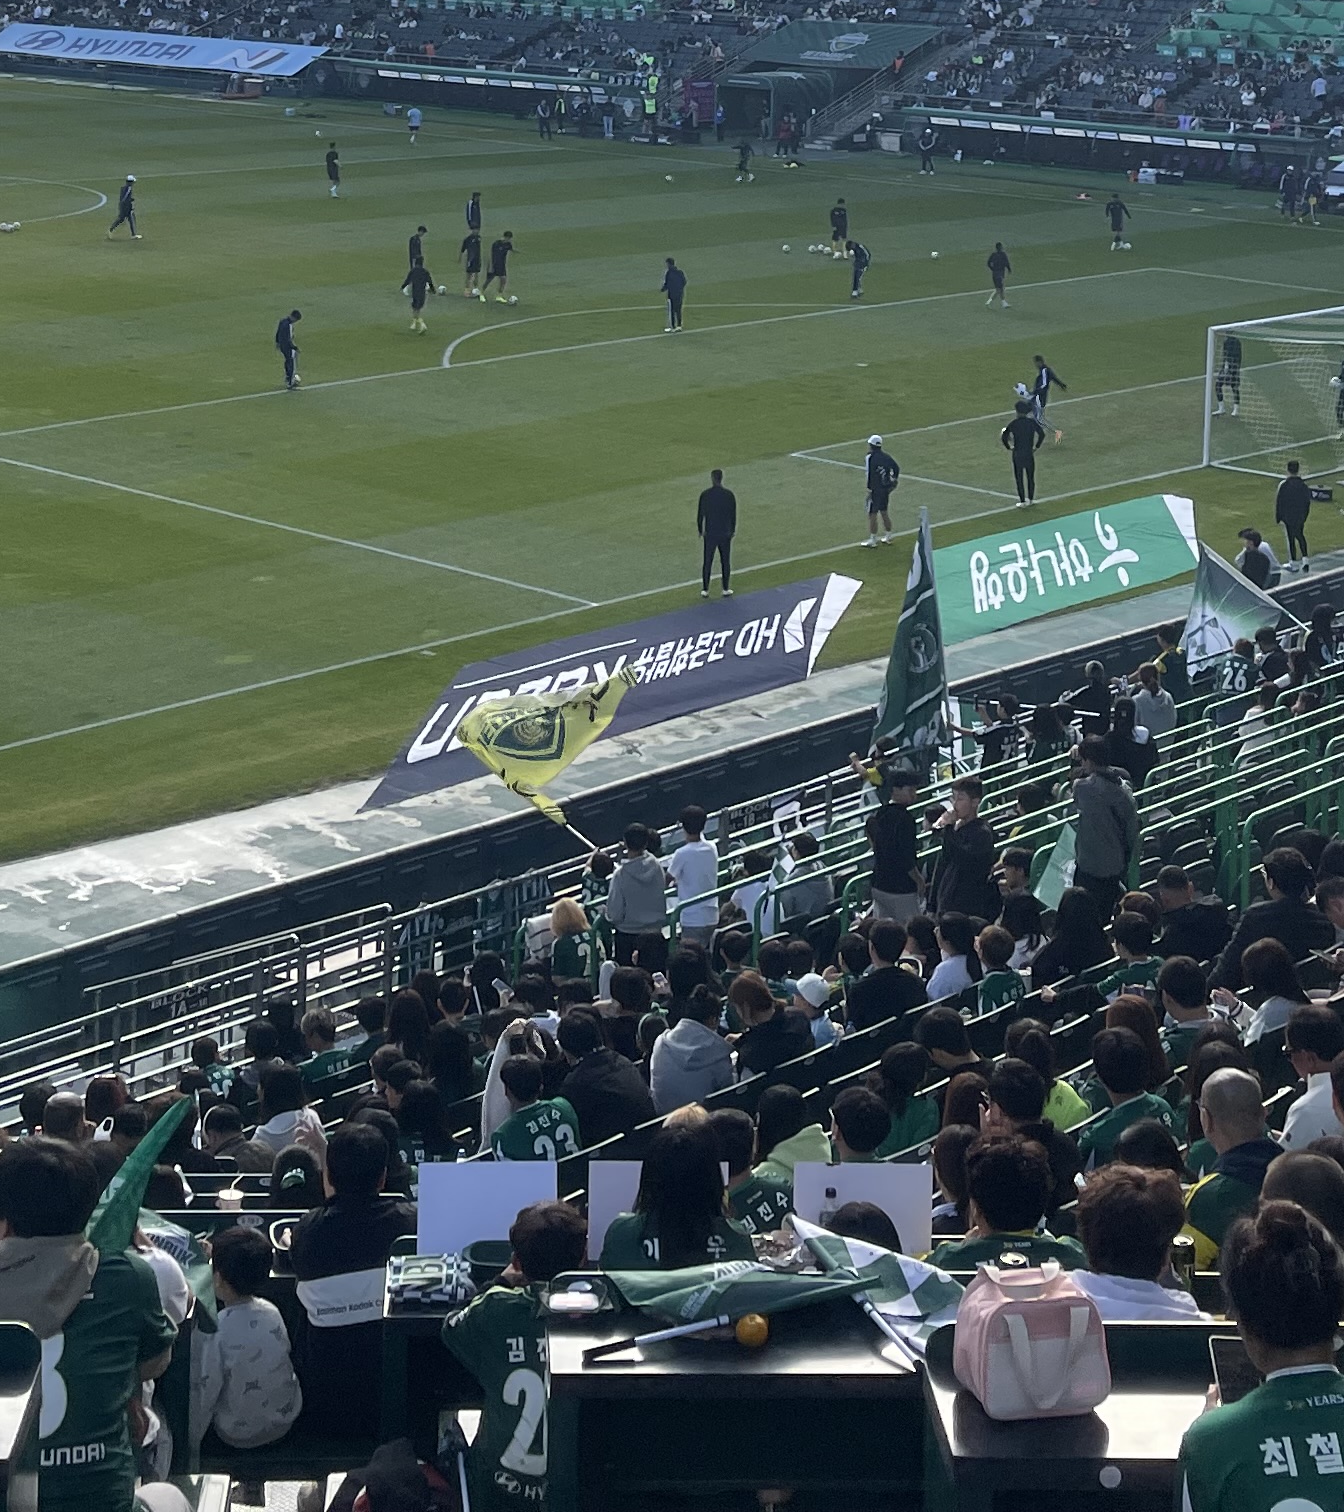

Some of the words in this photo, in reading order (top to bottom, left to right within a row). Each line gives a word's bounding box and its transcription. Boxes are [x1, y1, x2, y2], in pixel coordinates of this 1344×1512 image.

[64, 36, 196, 61] HYUNDAI
[970, 531, 1094, 615] 하나은행
[733, 613, 780, 660] HD
[1222, 667, 1248, 692] 26
[525, 1109, 561, 1134] 김진수
[349, 1302, 374, 1312] Kodak
[1305, 1393, 1344, 1409] YEARS
[40, 1442, 105, 1466] UNDAI
